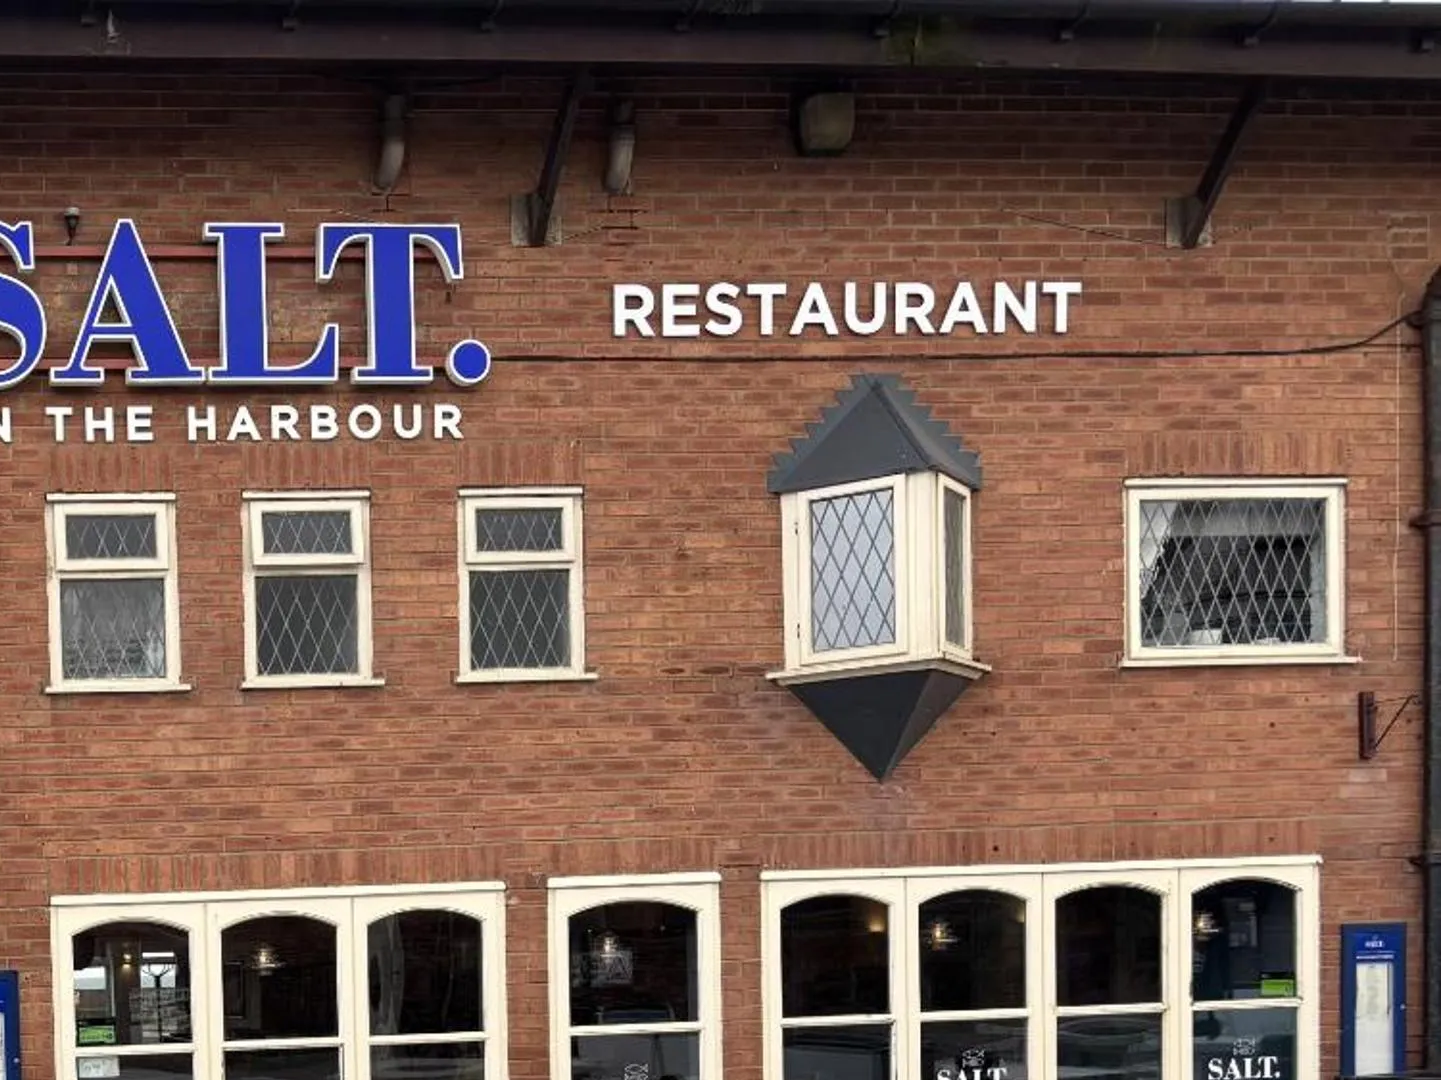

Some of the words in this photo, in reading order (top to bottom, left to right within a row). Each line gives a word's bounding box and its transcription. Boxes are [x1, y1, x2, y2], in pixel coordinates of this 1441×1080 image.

[612, 280, 1083, 338] RESTAURANT
[45, 405, 155, 443] THE
[187, 403, 465, 442] HARBOUR
[1208, 1056, 1281, 1080] SALT.
